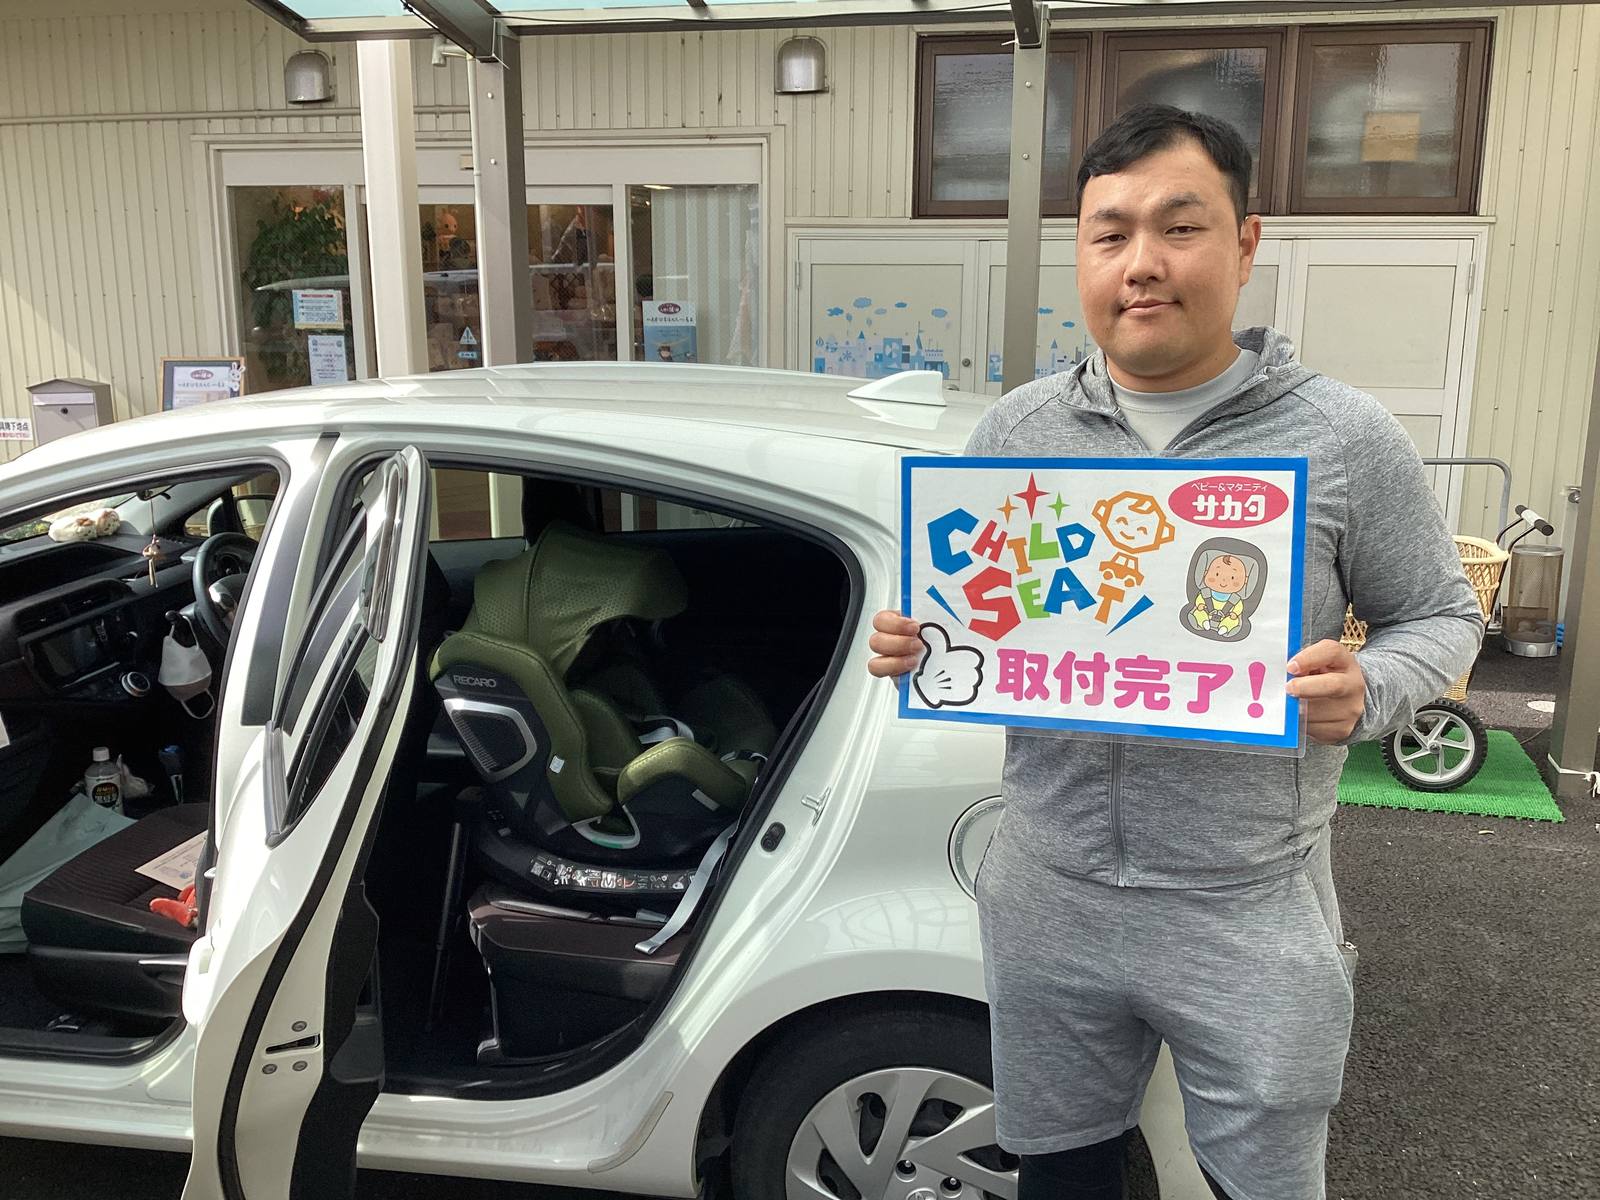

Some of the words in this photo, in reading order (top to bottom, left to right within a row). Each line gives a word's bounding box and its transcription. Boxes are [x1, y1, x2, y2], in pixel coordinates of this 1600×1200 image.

[926, 507, 1096, 576] CHILD
[1192, 494, 1266, 521] サカタ
[961, 565, 1126, 642] SEAT
[453, 674, 497, 688] RECARO
[995, 648, 1267, 719] 取付完了！
